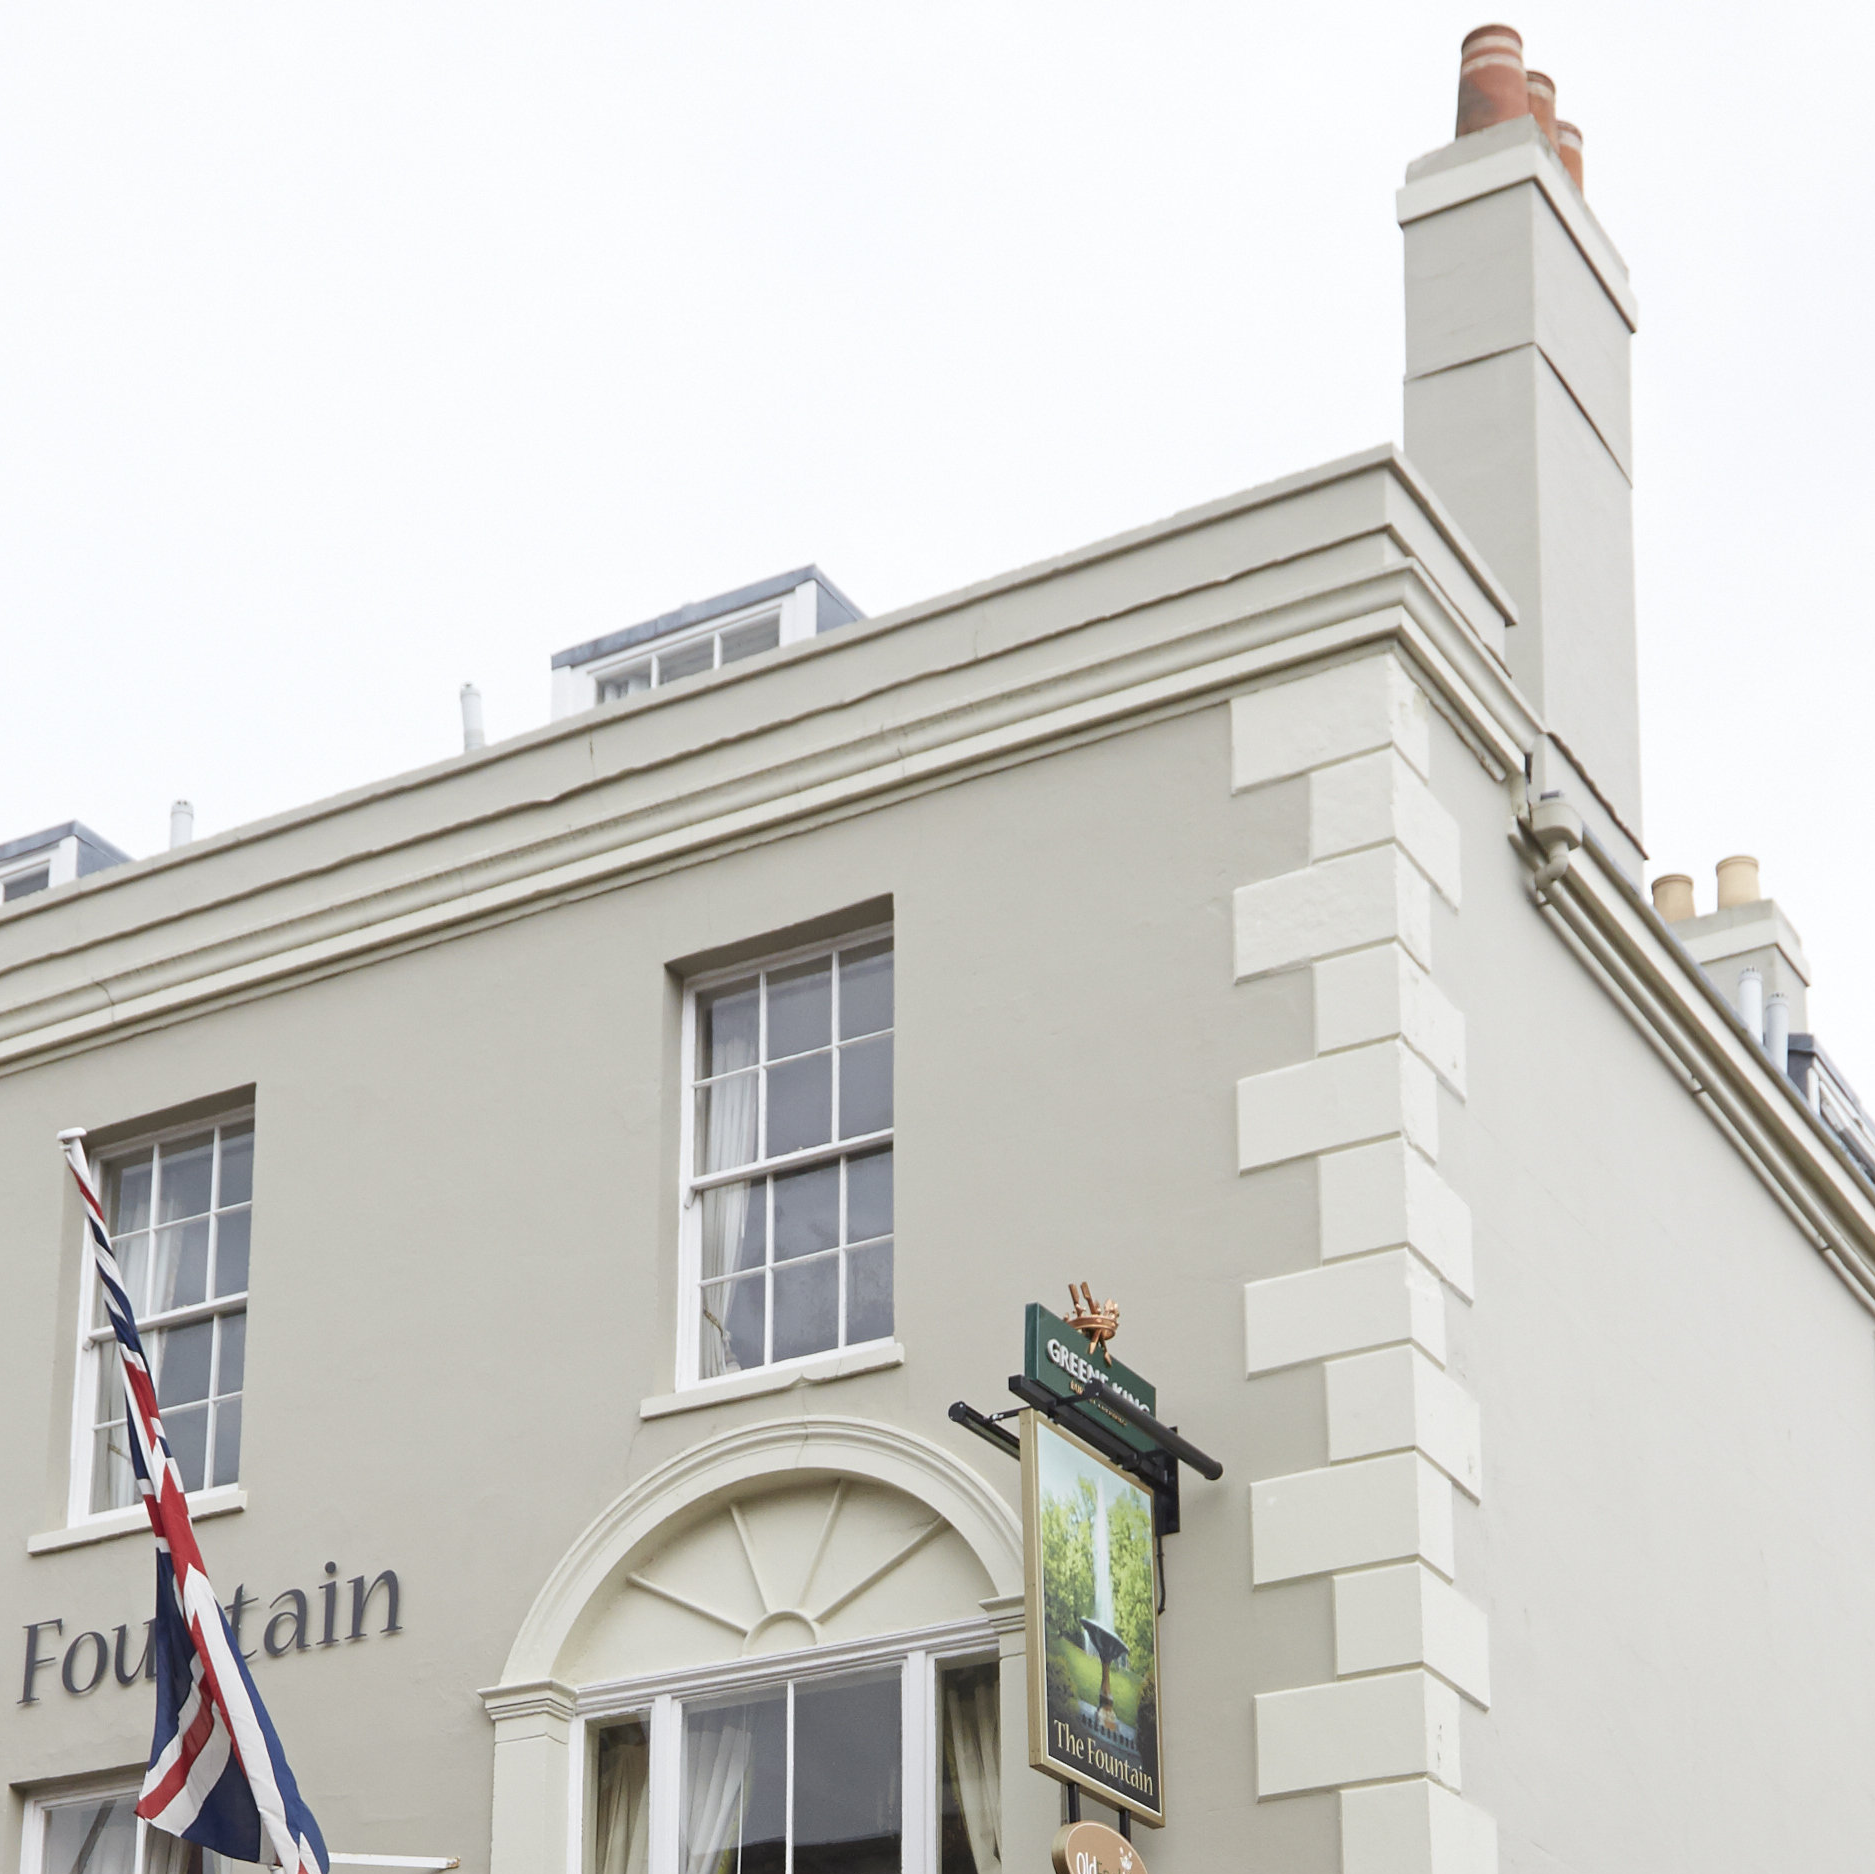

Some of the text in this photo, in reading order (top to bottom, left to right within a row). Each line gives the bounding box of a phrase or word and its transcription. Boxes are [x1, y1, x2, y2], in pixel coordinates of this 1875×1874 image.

[17, 1560, 404, 1706] Foutain
[1053, 1719, 1154, 1797] The Fountain
